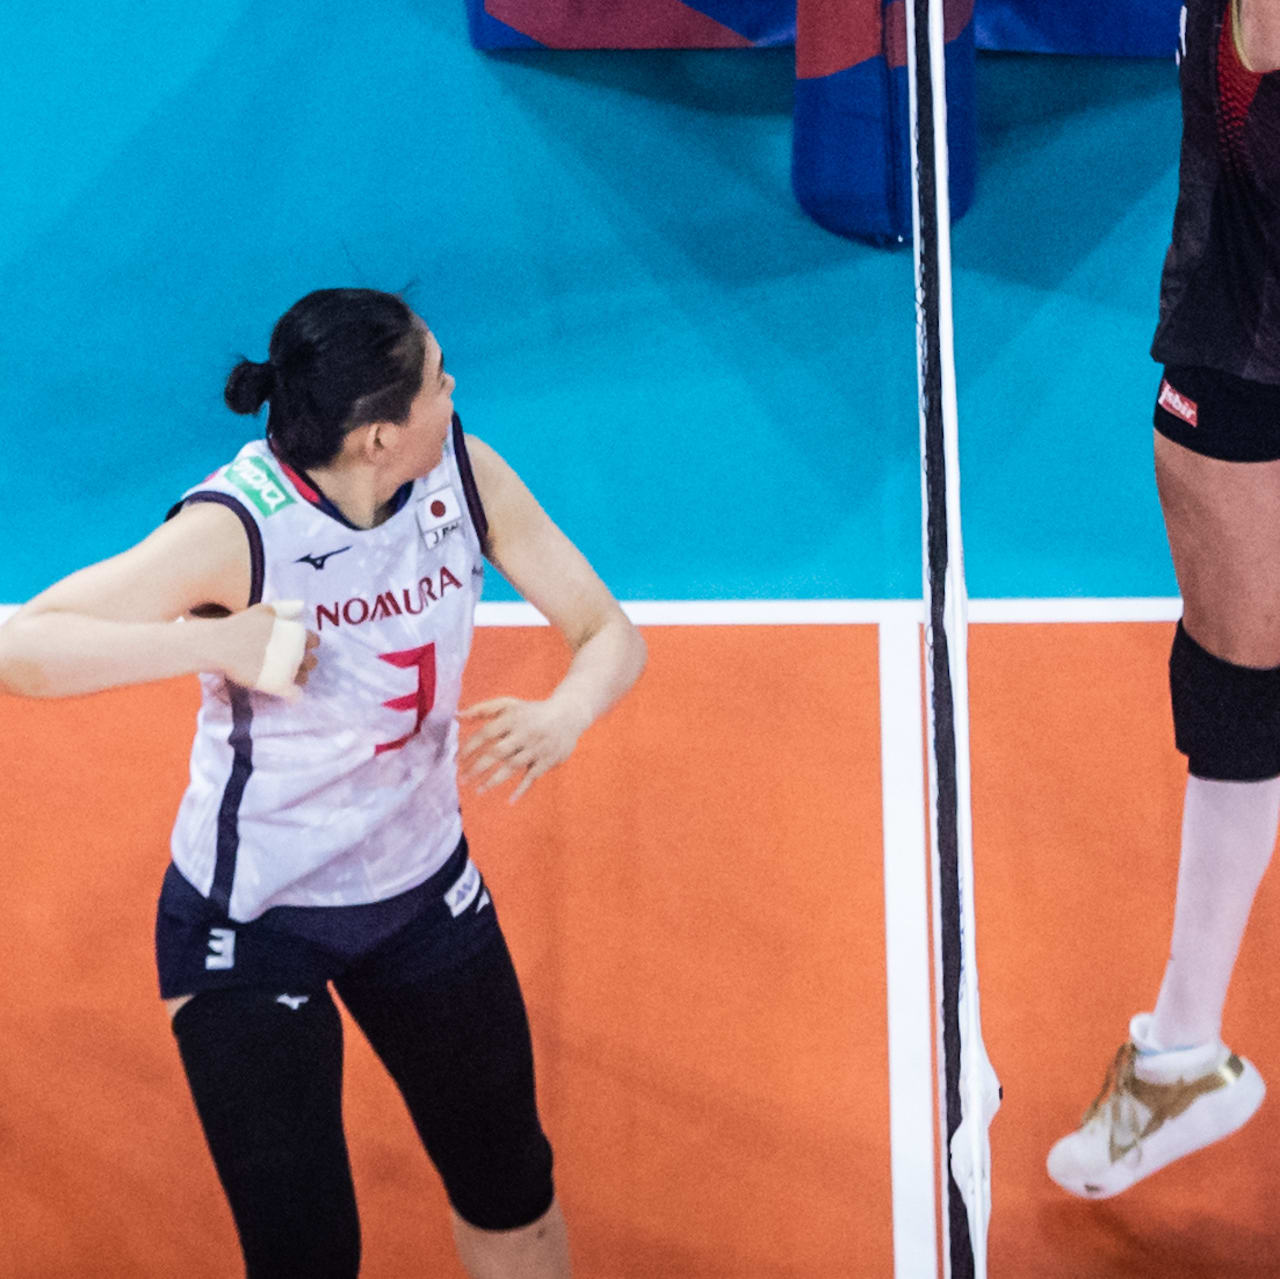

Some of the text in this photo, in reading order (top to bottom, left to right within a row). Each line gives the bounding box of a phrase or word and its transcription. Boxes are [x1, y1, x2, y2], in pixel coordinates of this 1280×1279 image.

[316, 566, 463, 631] NOMURA
[374, 641, 437, 756] 3
[205, 928, 236, 970] 3
